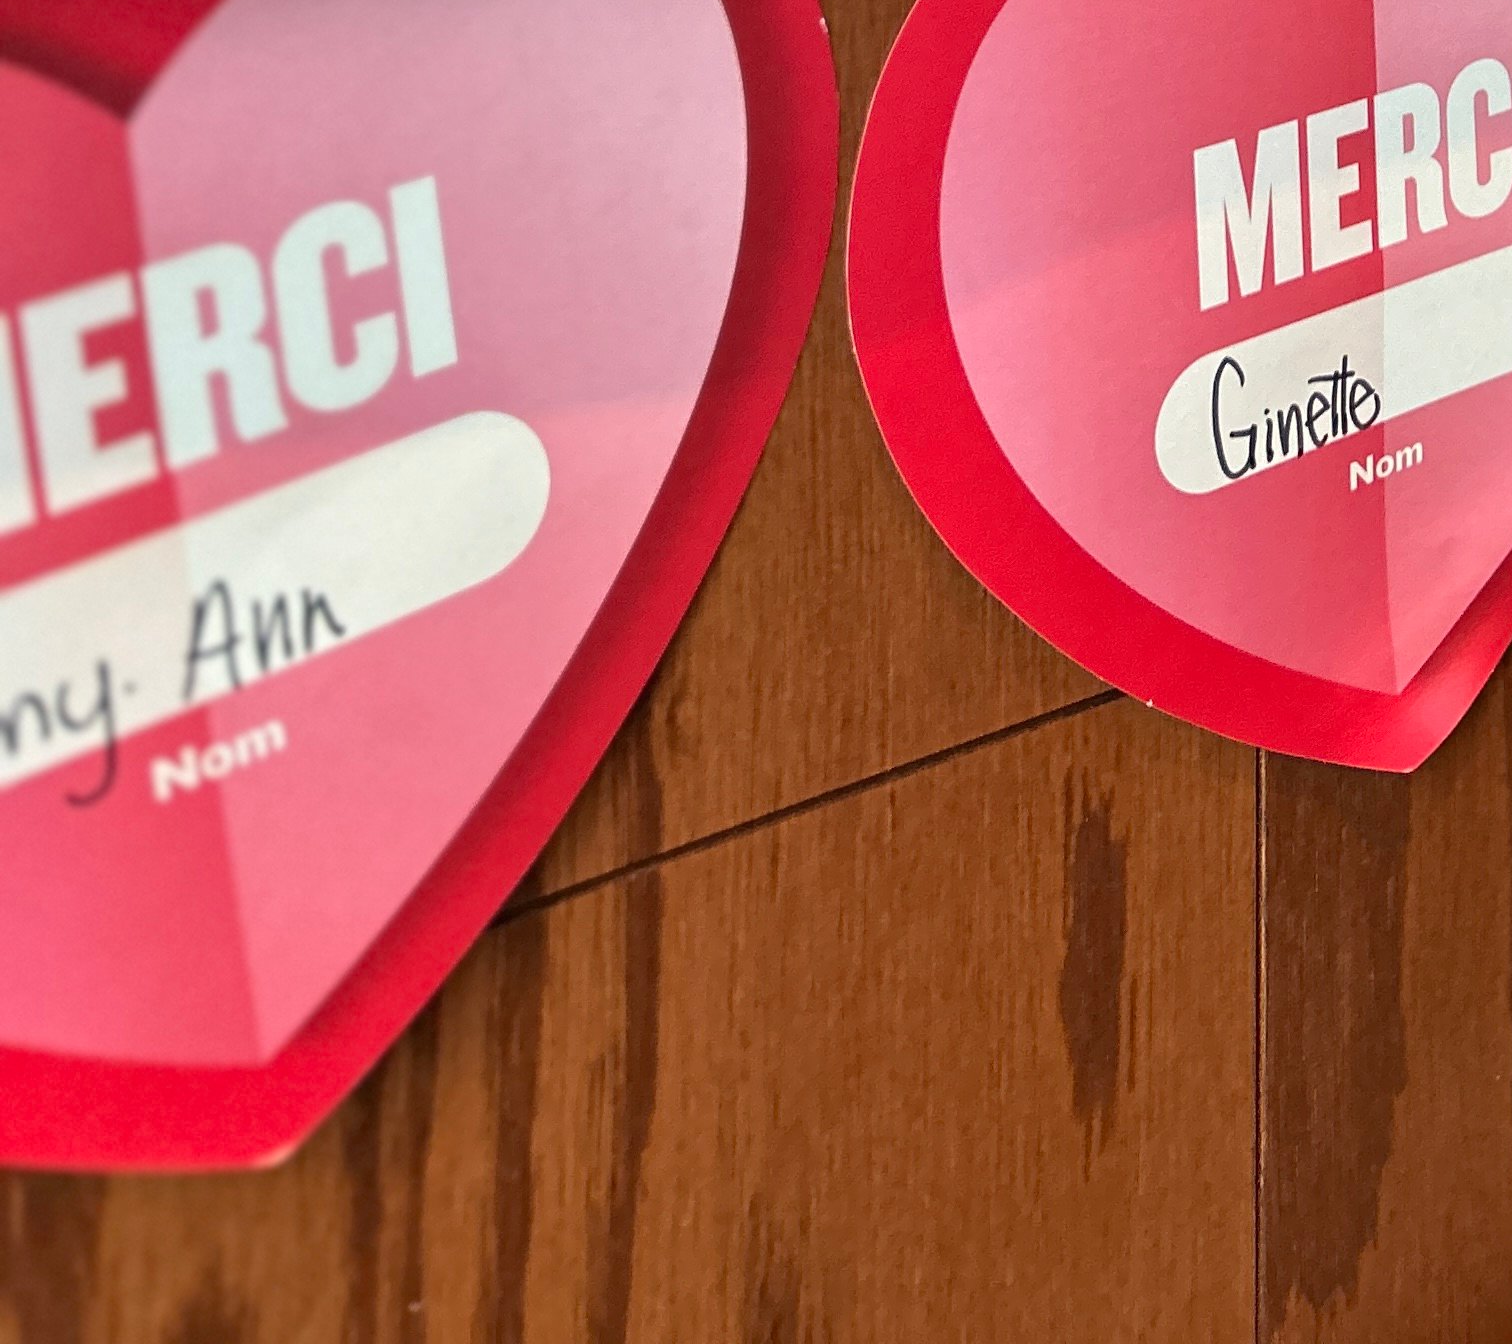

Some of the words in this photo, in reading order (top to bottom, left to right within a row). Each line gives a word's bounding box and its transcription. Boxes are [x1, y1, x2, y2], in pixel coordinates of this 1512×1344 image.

[0, 175, 458, 536] ERCI
[1211, 355, 1382, 480] Ginette
[1348, 441, 1425, 493] Nom
[180, 575, 347, 705] Ann
[150, 717, 288, 805] Nom
